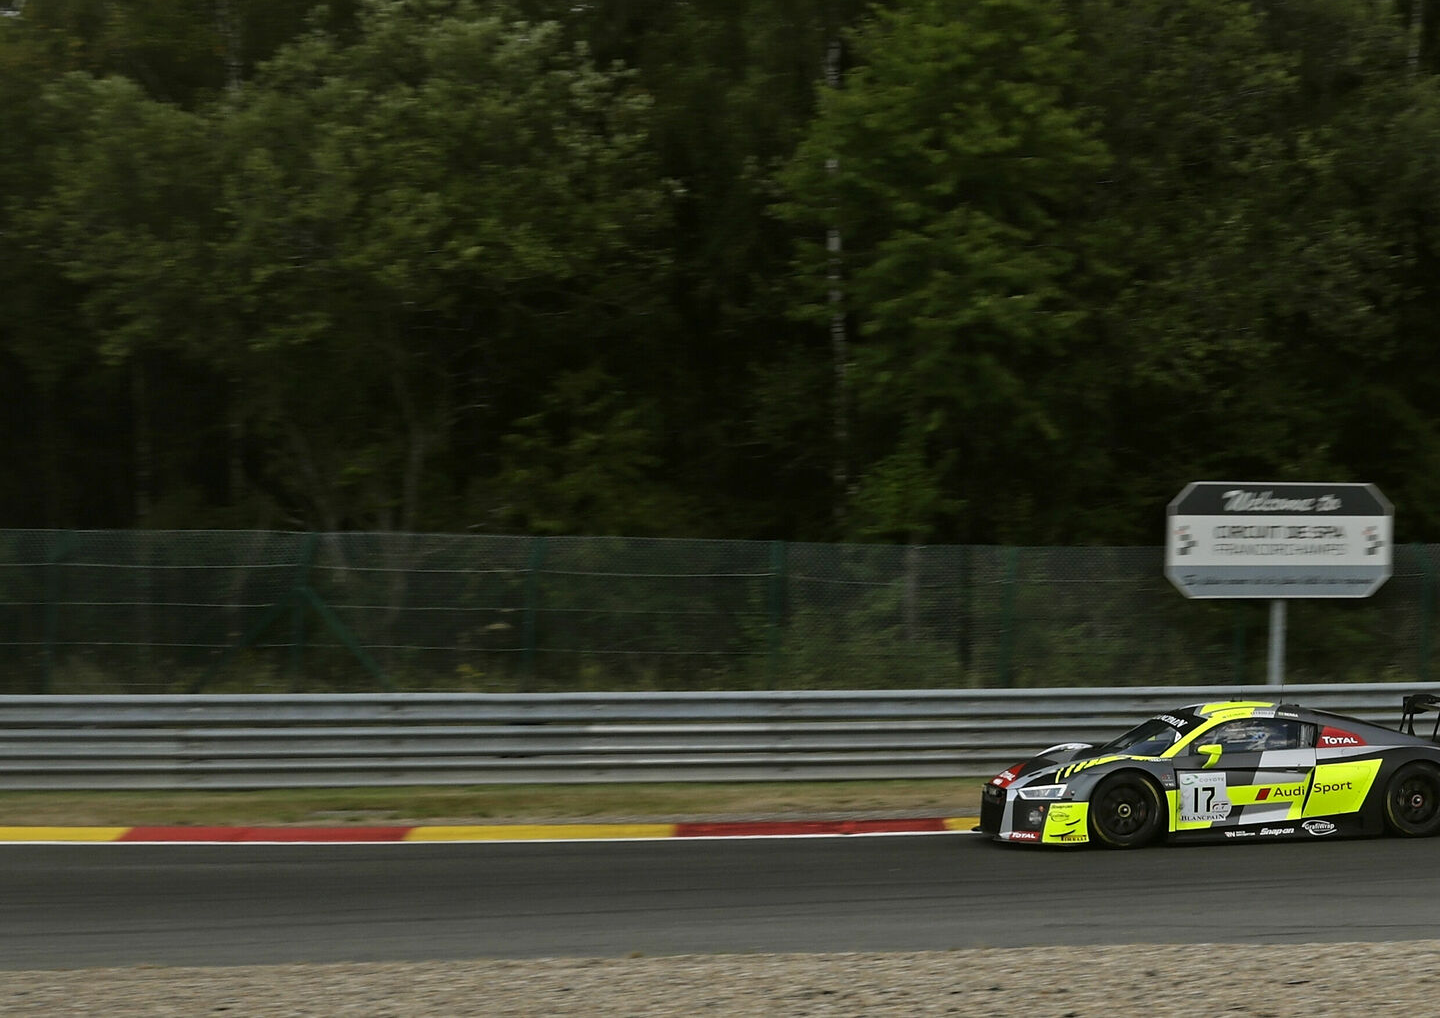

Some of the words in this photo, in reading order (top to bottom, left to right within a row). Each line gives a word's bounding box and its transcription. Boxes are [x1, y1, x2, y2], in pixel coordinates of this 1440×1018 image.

[1221, 489, 1313, 512] Welcome
[1313, 492, 1342, 512] to
[1212, 525, 1284, 540] CIRCUIT
[1321, 736, 1358, 745] TOTAL
[1273, 785, 1305, 797] Audi
[1313, 781, 1353, 795] Sport
[1193, 786, 1216, 813] 17
[1181, 814, 1225, 822] BLANCPAIN
[1259, 828, 1295, 836] Snap-on
[1304, 822, 1335, 831] GrafiWrap
